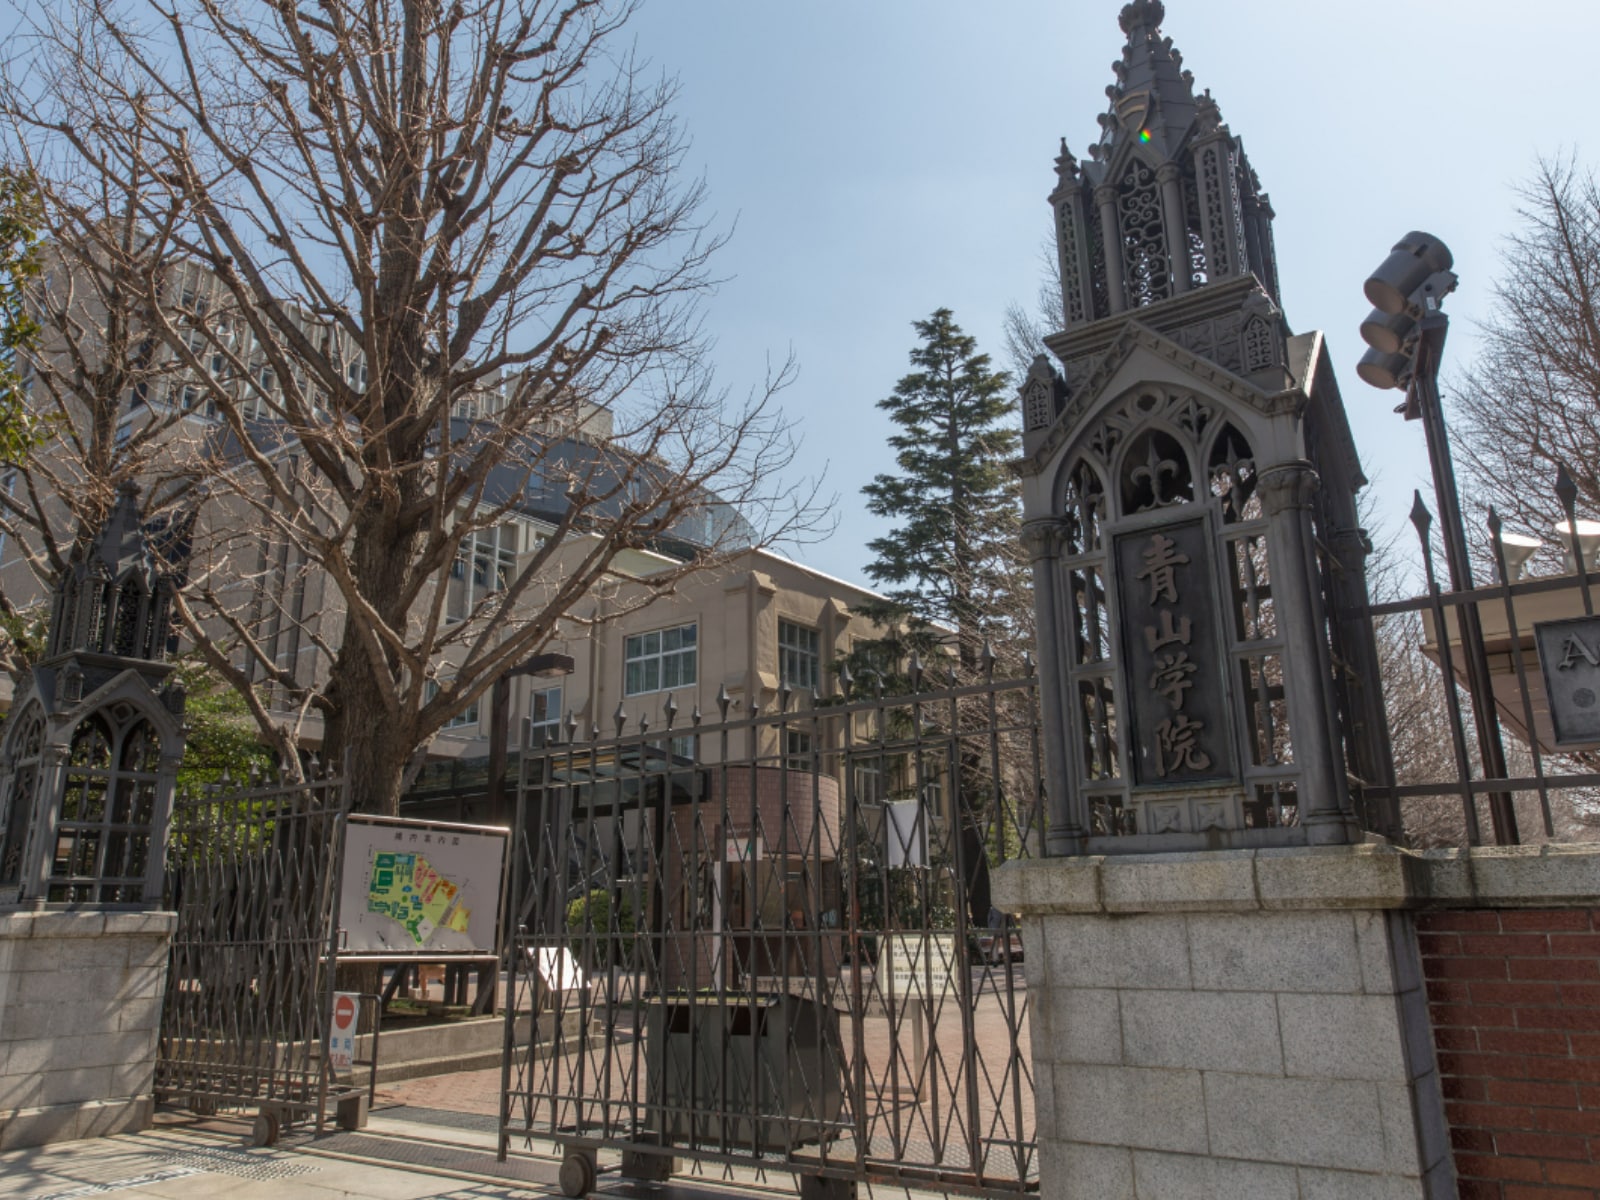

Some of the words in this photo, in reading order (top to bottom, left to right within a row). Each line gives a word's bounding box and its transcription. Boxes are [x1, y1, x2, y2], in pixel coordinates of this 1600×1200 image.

[1136, 533, 1211, 777] 青山学院
[1558, 632, 1600, 669] A
